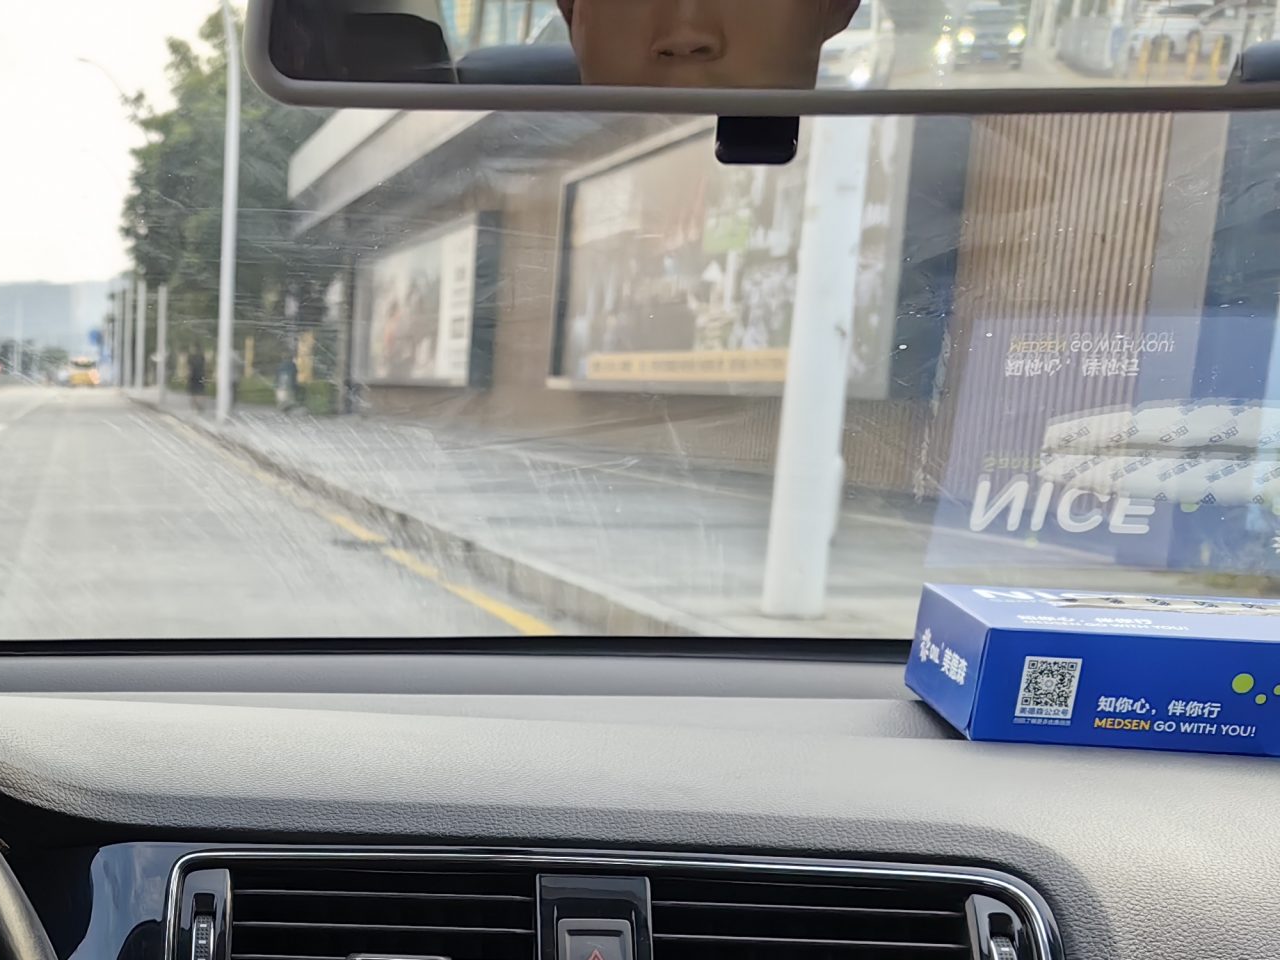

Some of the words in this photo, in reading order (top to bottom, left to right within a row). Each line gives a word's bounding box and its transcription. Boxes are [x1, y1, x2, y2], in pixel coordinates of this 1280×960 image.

[1096, 695, 1221, 718] 知你心，伴你行
[1094, 717, 1150, 731] MEDSEN
[1153, 721, 1176, 732] GO
[1180, 722, 1217, 735] WITH
[1221, 724, 1257, 737] YOU!
